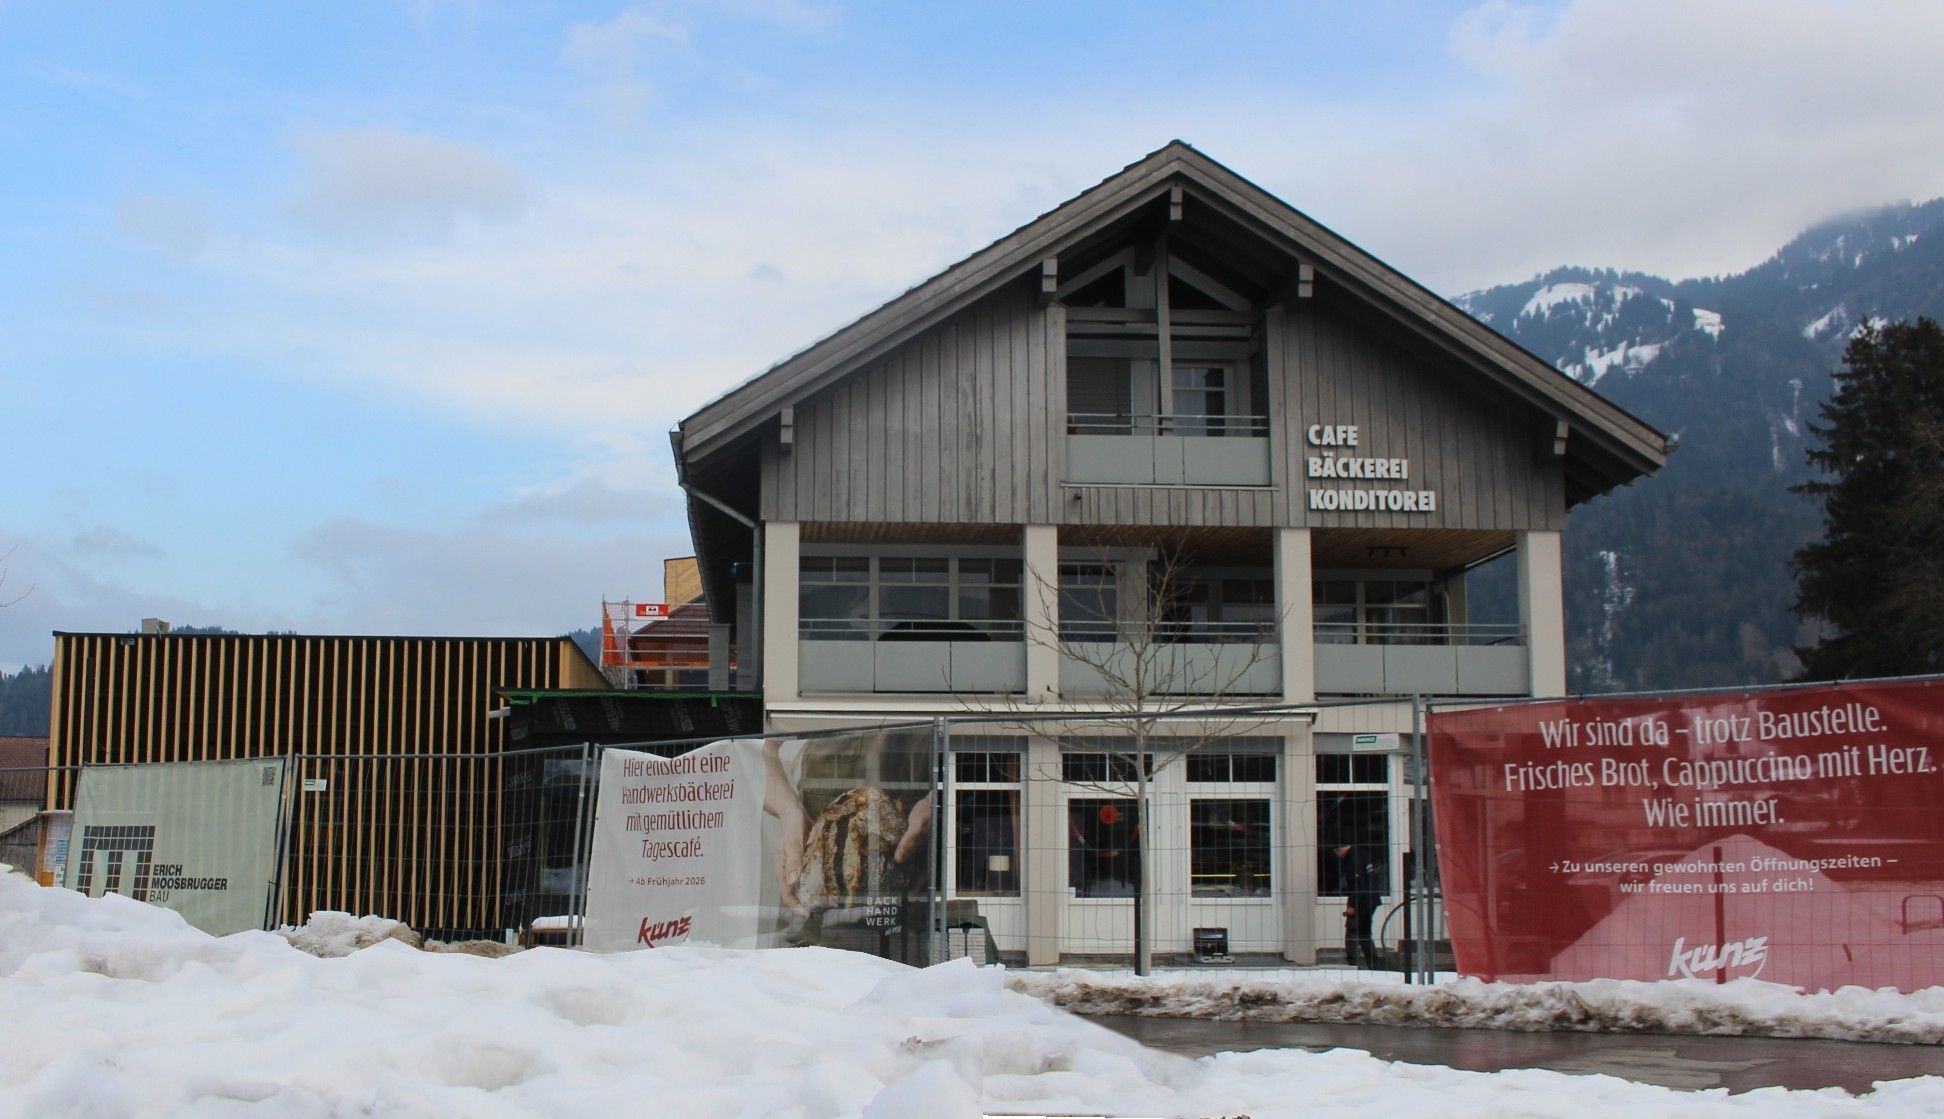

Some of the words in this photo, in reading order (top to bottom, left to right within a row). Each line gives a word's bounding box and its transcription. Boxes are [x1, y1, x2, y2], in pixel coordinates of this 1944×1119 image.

[1308, 424, 1358, 446] CAFE
[1308, 451, 1408, 480] BÄCKEREI
[1309, 489, 1436, 512] KONDITOREI
[1539, 717, 1580, 749] Wir
[1585, 717, 1634, 747] sind
[1639, 717, 1670, 748] da
[1694, 714, 1752, 745] trotz
[1758, 703, 1888, 741] Baustelle.
[623, 758, 645, 778] Hier
[700, 753, 731, 773] eine
[1504, 760, 1595, 792] Frisches
[1601, 758, 1658, 790] Brot,
[1663, 751, 1812, 790] Cappuccino
[1818, 745, 1862, 778] mit
[1867, 744, 1937, 776] Herz.
[622, 779, 735, 805] Handwerksbäckerei
[626, 812, 642, 832] mit
[643, 810, 724, 835] gemütlichem
[1643, 797, 1689, 828] Wie
[1694, 797, 1785, 828] immer.
[642, 836, 704, 861] Tagescafé.
[152, 864, 183, 876] ERICH
[1562, 860, 1581, 873] Zu
[1585, 860, 1649, 873] unseren
[1653, 858, 1745, 876] gewohnten
[1750, 854, 1881, 873] Öffnungszeiten
[150, 877, 228, 890] MOOSBRUGGER
[635, 877, 646, 886] Ab
[647, 876, 683, 888] Frühjahr
[685, 876, 706, 886] 2026
[1620, 879, 1645, 894] wir
[1649, 879, 1702, 894] freuen
[1708, 882, 1737, 894] uns
[1741, 878, 1768, 893] auf
[1772, 878, 1814, 892] dich!
[149, 890, 170, 902] BAU
[866, 896, 898, 906] BACK
[865, 917, 897, 926] WERK
[866, 906, 898, 916] HAND
